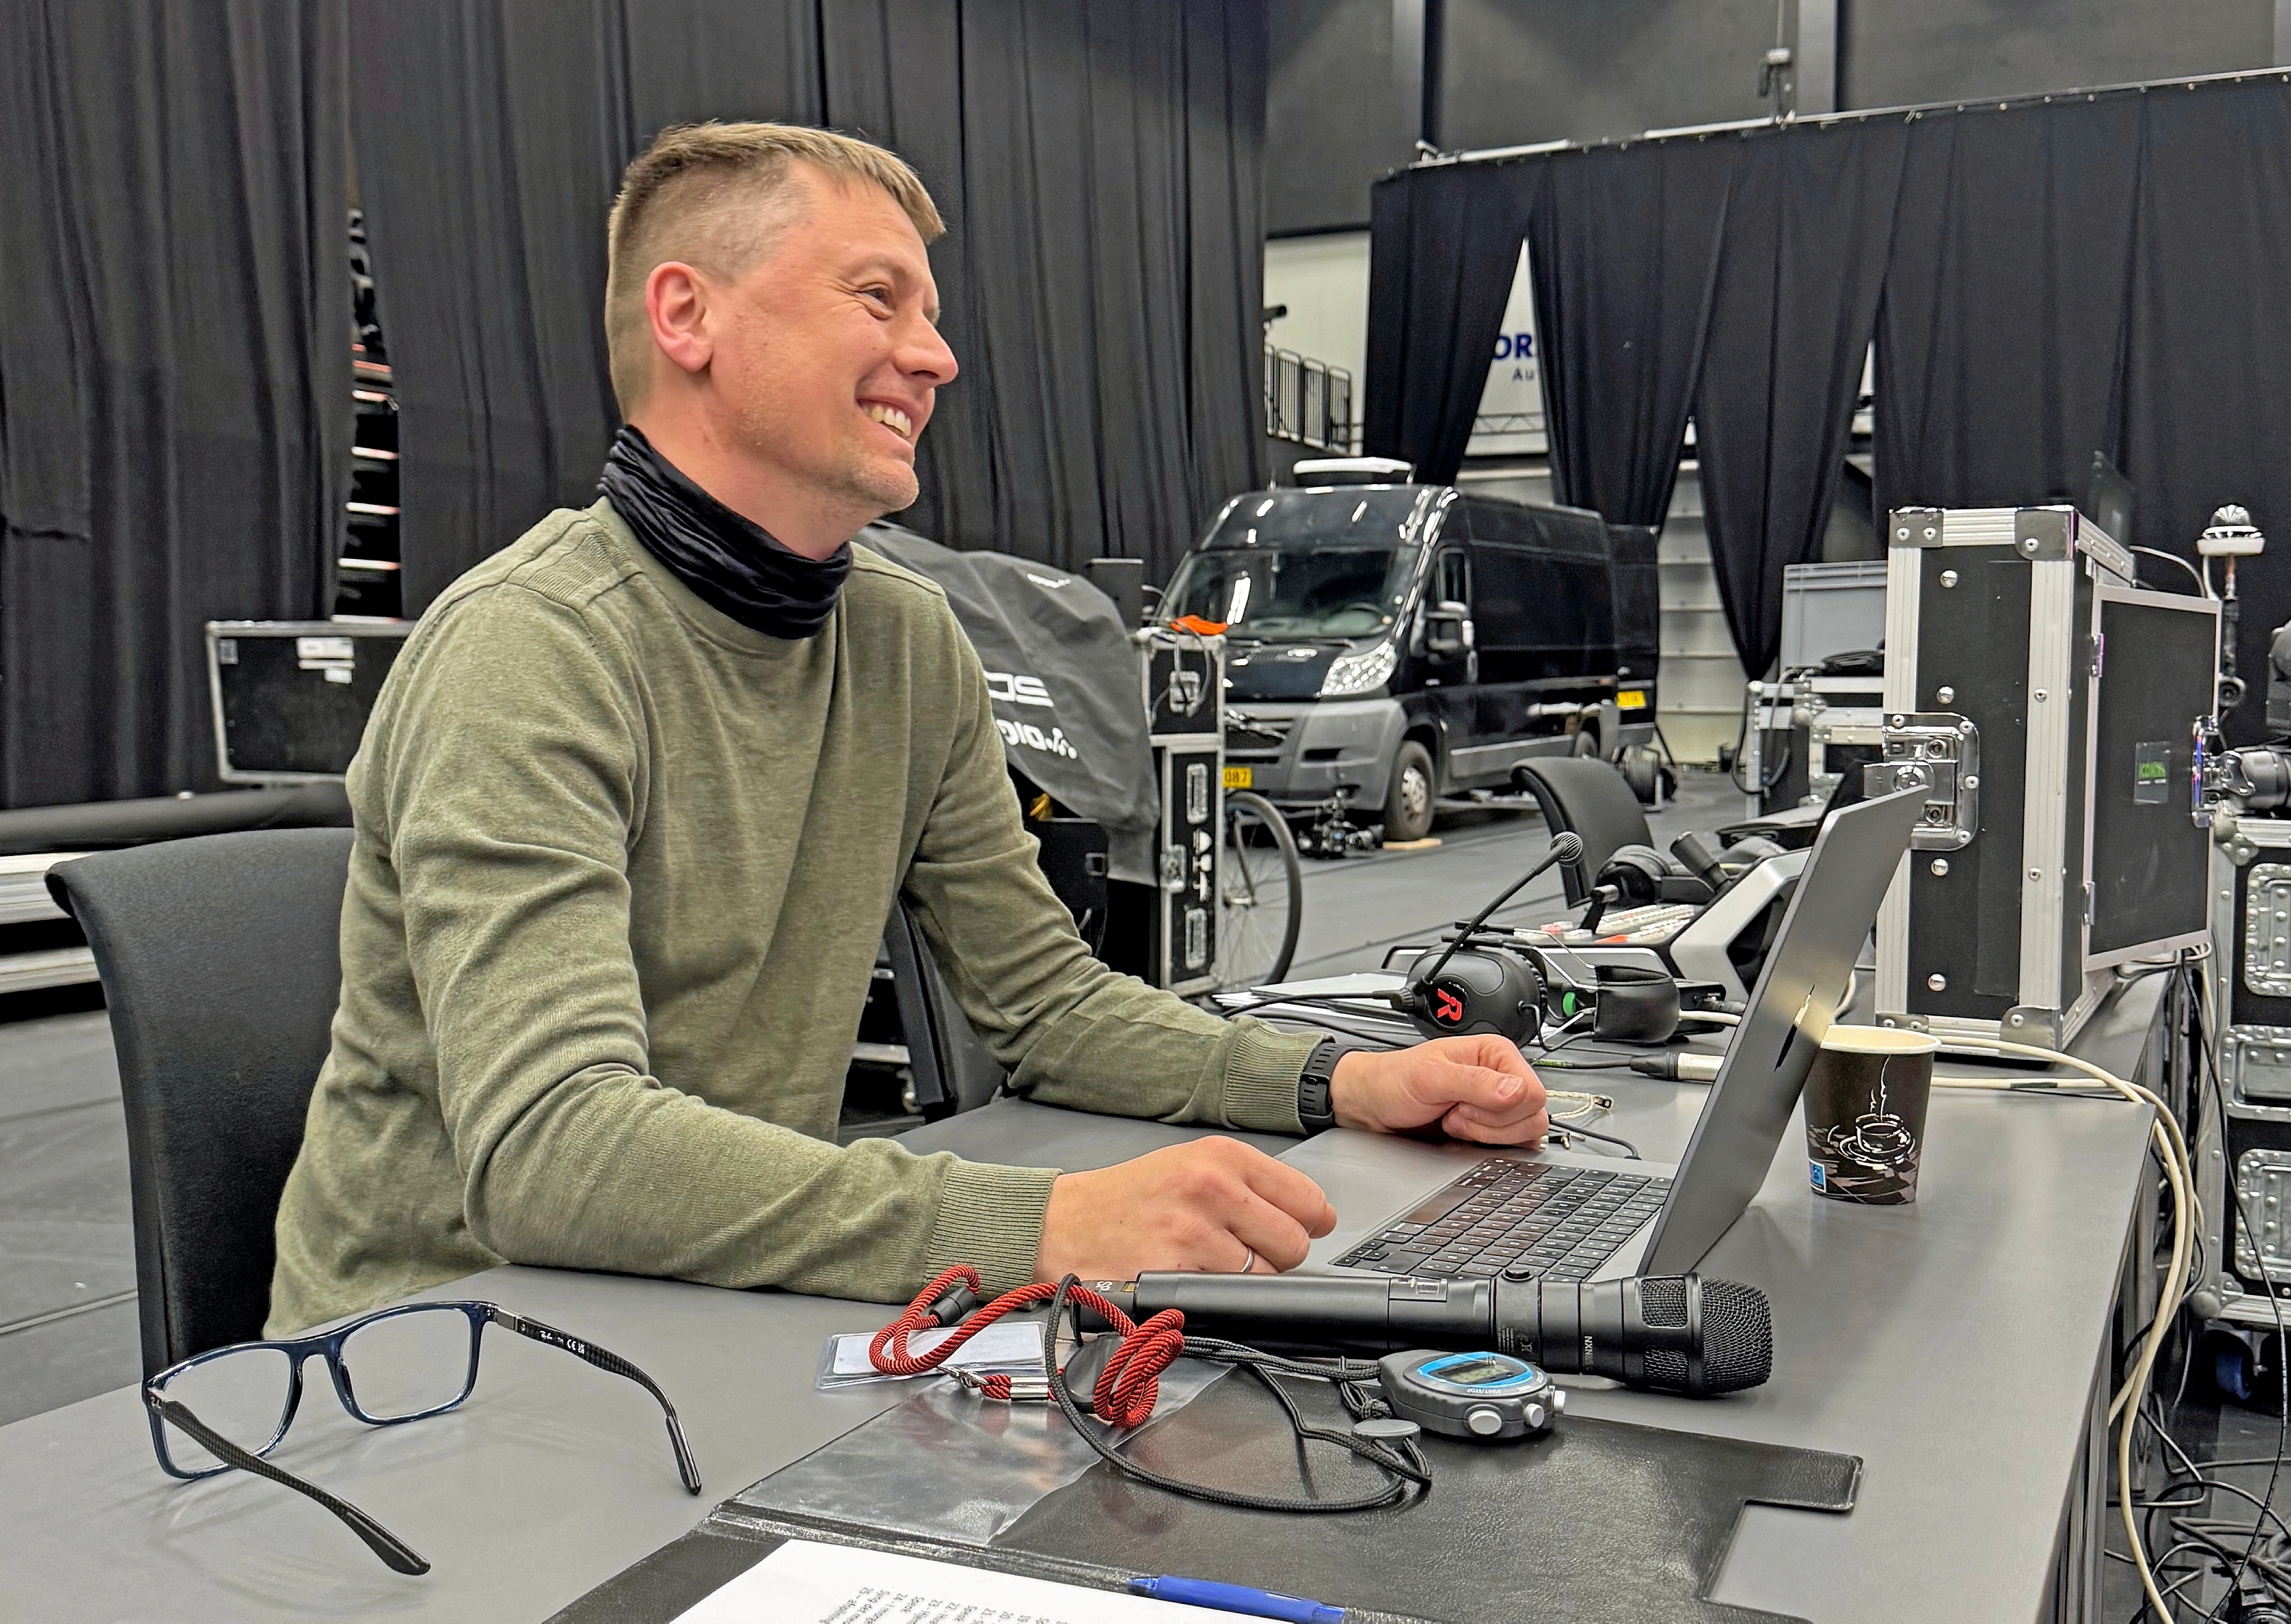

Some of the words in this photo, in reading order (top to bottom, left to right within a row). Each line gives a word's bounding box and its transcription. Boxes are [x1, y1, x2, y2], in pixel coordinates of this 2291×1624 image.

[893, 1593, 908, 1601] 24
[900, 1595, 925, 1613] Speak
[928, 1599, 943, 1607] 23
[945, 1602, 961, 1610] 22
[953, 1605, 977, 1622] Speak
